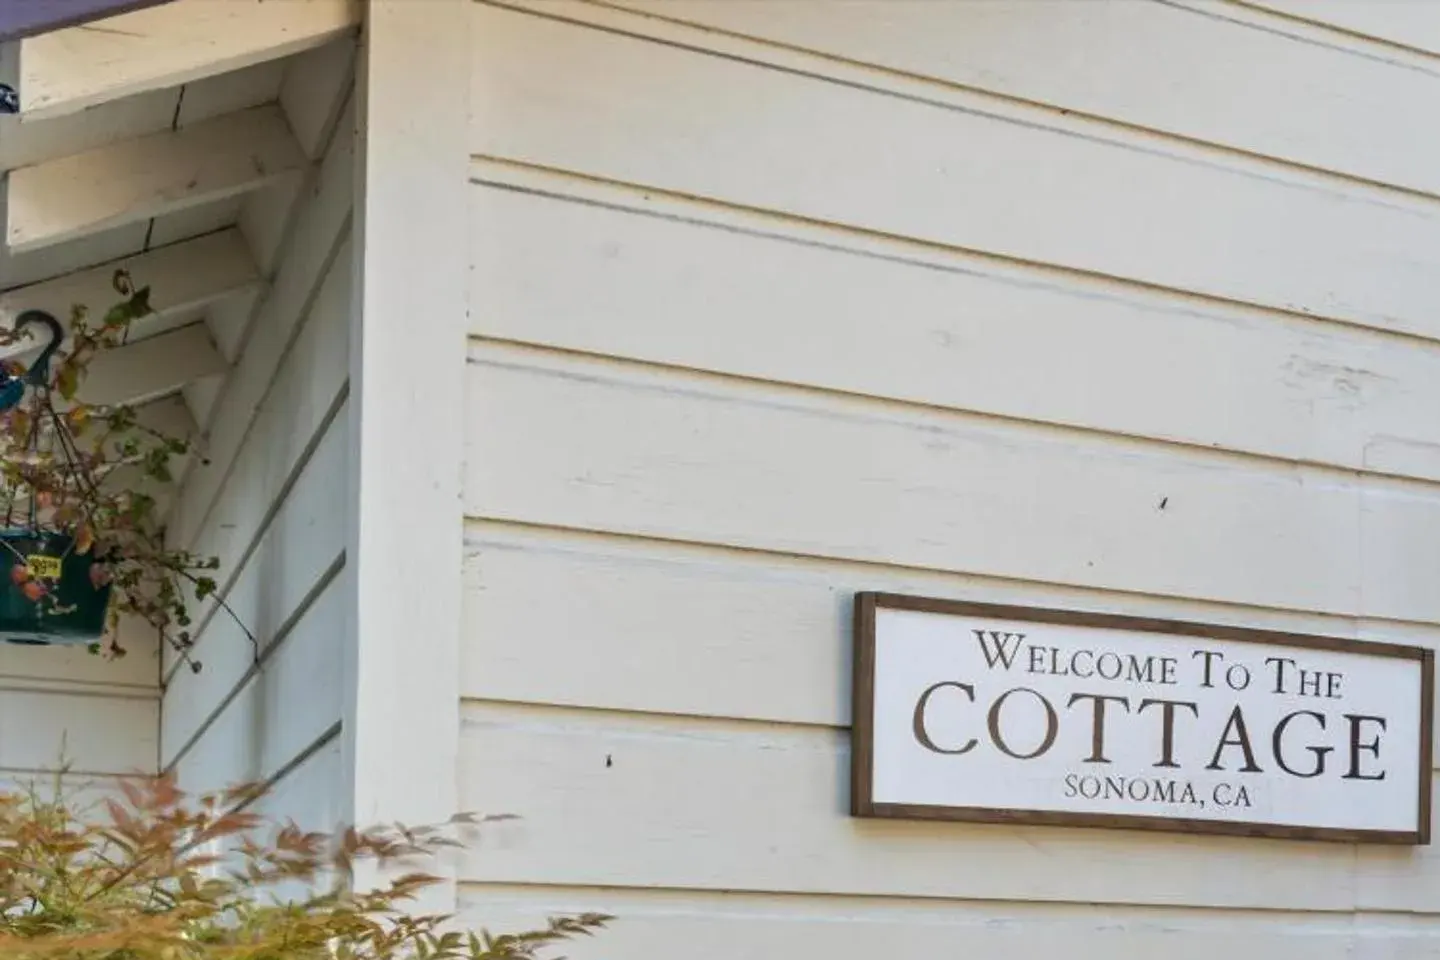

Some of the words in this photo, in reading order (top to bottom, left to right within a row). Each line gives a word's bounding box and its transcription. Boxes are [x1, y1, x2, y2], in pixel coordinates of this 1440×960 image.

[973, 629, 1178, 685] WELCOME
[1191, 650, 1251, 692] TO
[1265, 657, 1343, 699] THE
[913, 680, 1387, 781] COTTAGE
